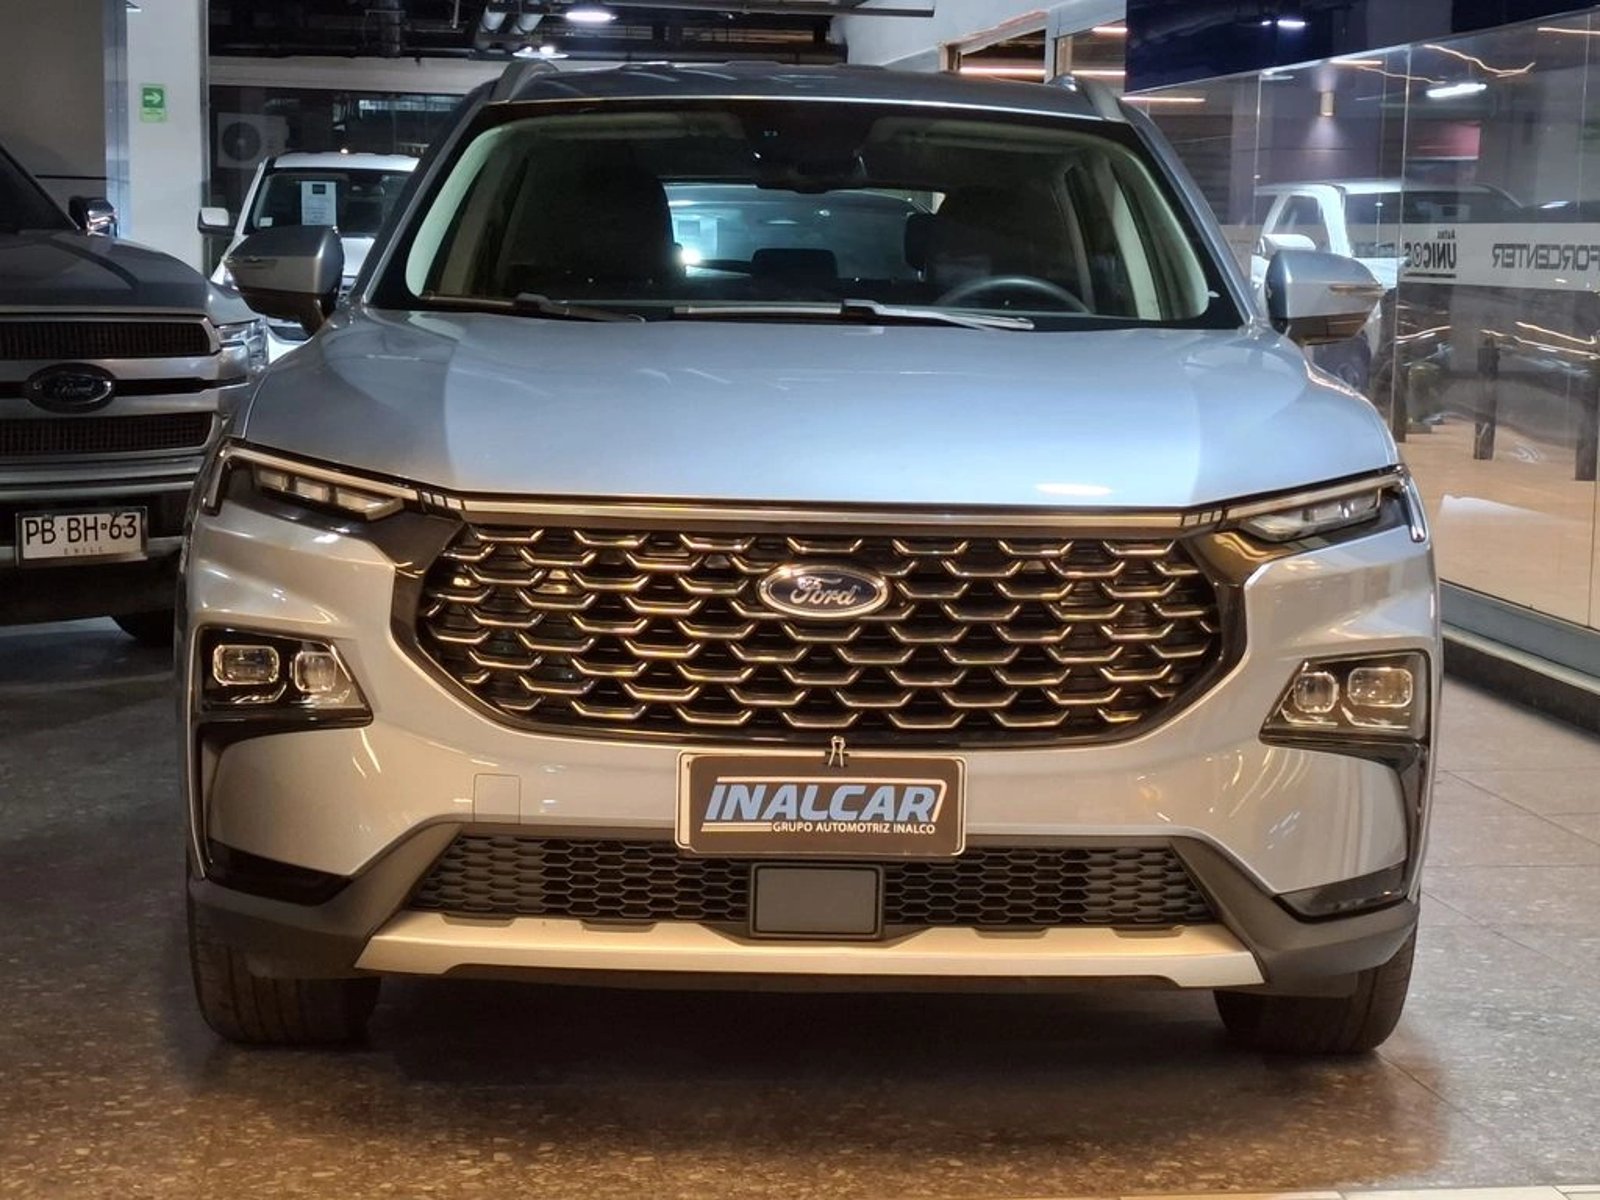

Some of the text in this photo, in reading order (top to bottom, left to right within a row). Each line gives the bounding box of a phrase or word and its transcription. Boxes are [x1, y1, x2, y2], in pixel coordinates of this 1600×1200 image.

[789, 575, 861, 605] Ford
[704, 784, 936, 822] INALCAR
[772, 822, 936, 835] GRUPO AUTOMOTRIZ INALCO
